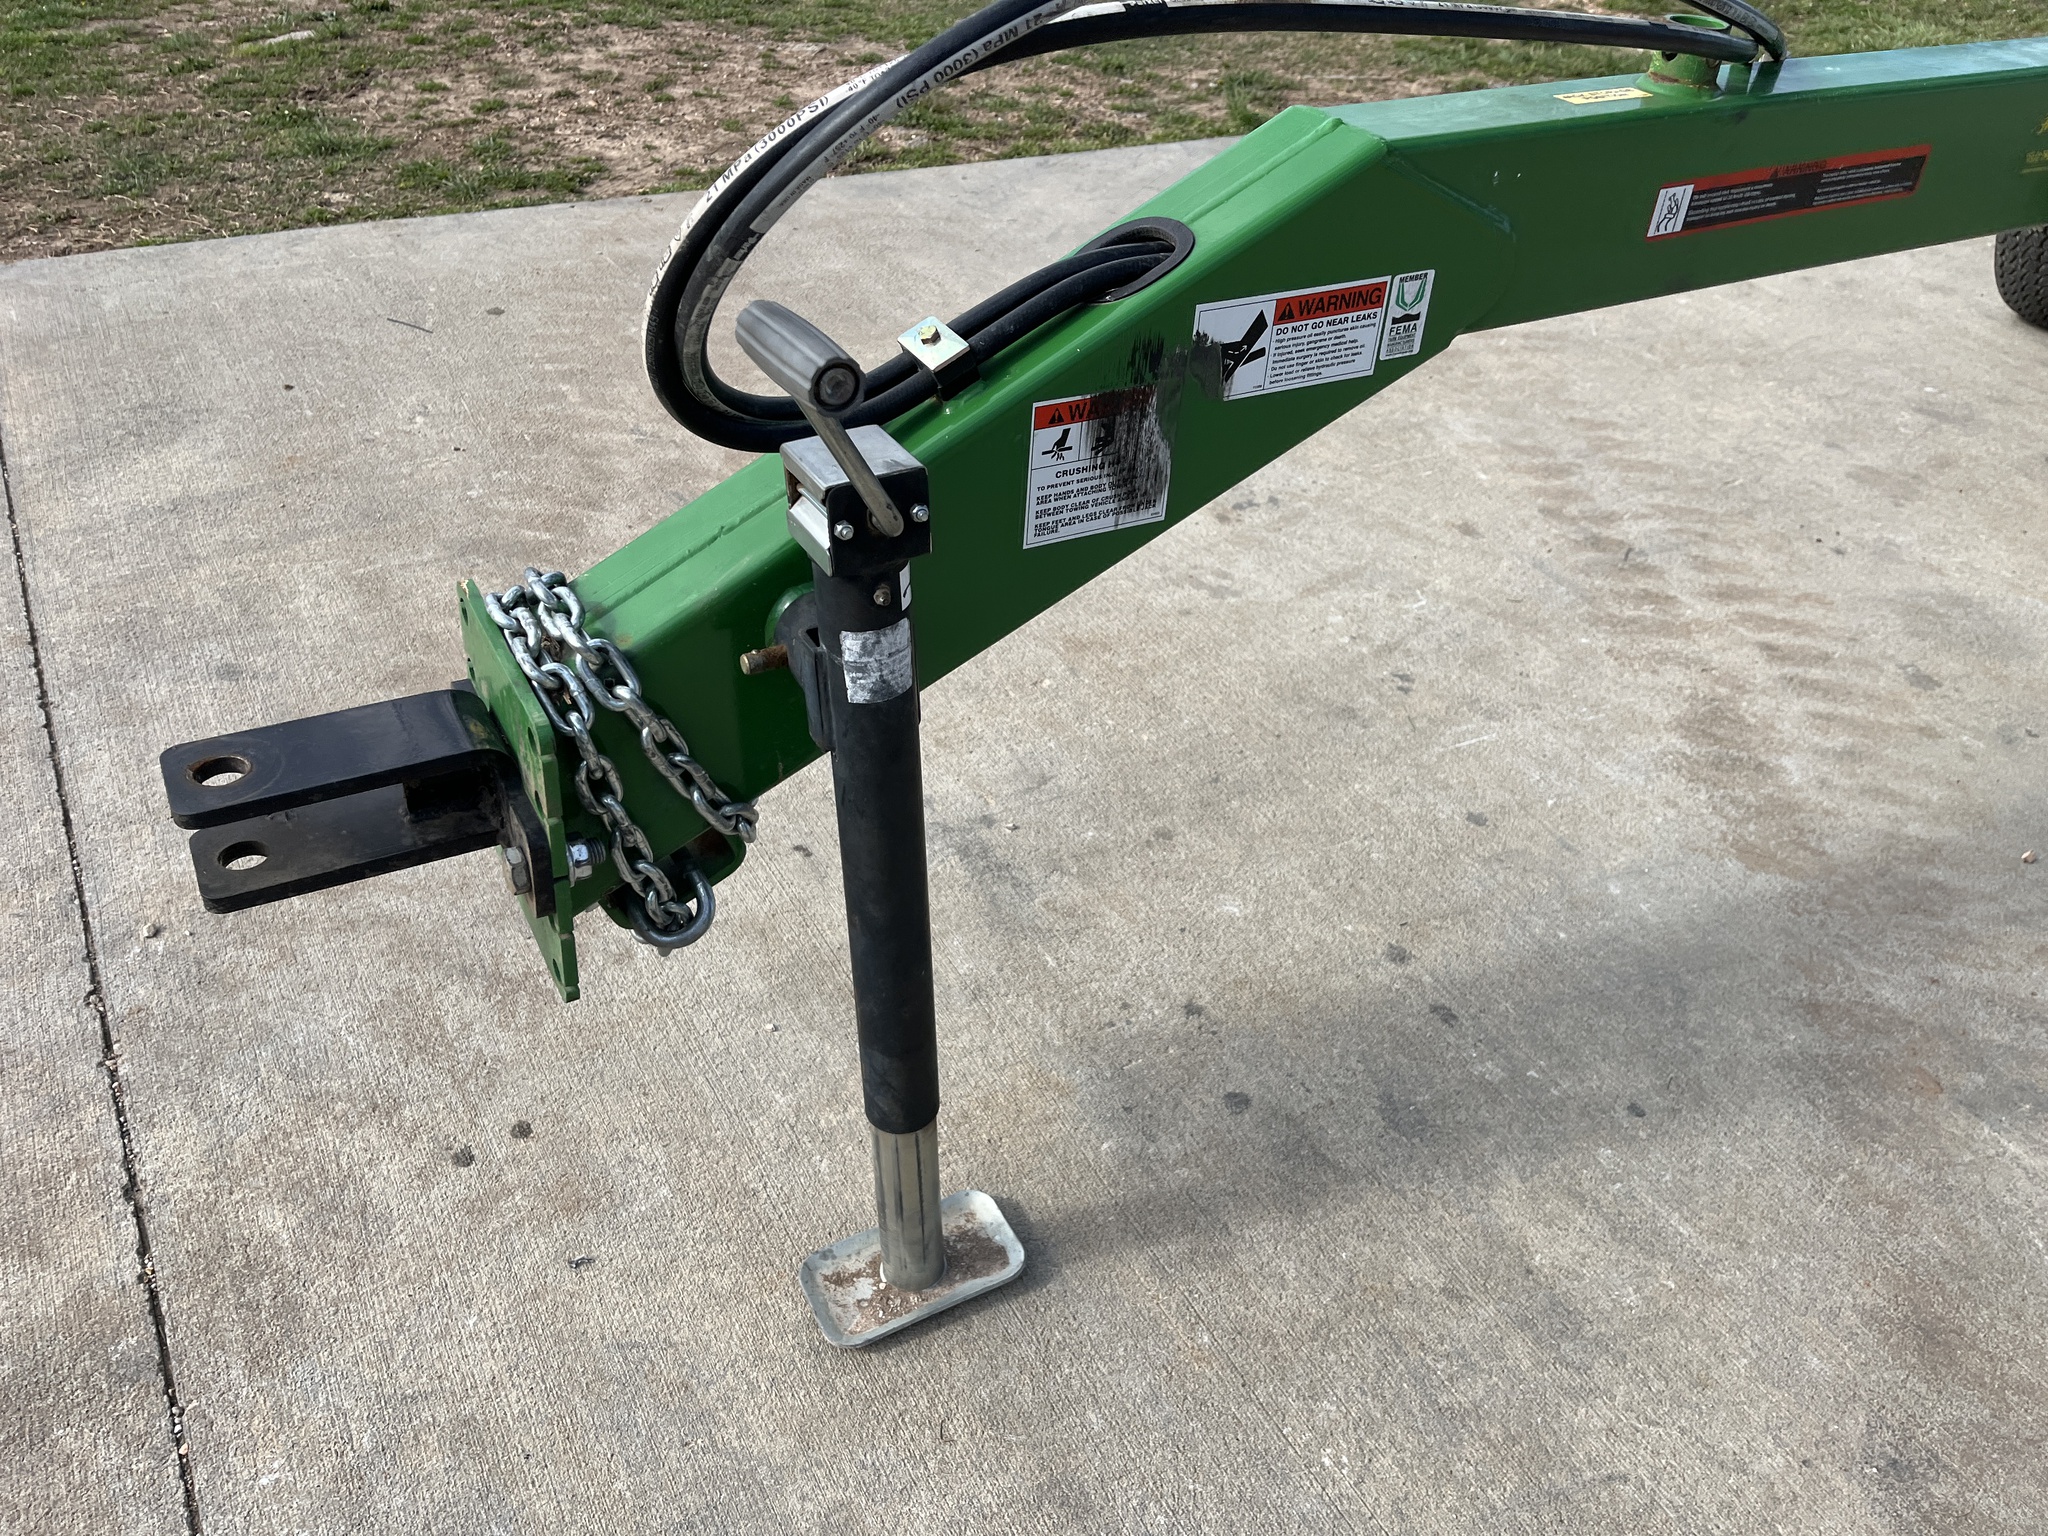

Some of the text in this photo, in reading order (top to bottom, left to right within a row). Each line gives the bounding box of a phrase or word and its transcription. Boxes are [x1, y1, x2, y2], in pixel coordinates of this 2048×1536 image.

[896, 13, 1045, 108] 21 MPa (3000 PSI)
[705, 183, 719, 203] 21
[721, 153, 753, 184] MPa
[754, 96, 829, 153] (3000PSI)
[1399, 272, 1428, 283] MEMBER
[1298, 288, 1382, 316] WARNING
[1276, 312, 1378, 336] DO NOT GO NEAR LEAKS
[1389, 322, 1417, 336] FEMA
[1055, 463, 1105, 478] CRUSHING
[1047, 480, 1074, 490] PREVENT
[1076, 474, 1102, 484] SERIOUS
[1054, 489, 1074, 498] HANDS
[1090, 482, 1106, 490] BODY
[1073, 488, 1106, 498] ATTACHING
[1035, 510, 1064, 520] BETWEEN
[1066, 505, 1089, 513] TOWING
[1091, 499, 1115, 508] VEHICLE
[1070, 500, 1090, 508] CLEAR
[1082, 511, 1097, 519] LEGS
[1099, 507, 1117, 515] CLEAR
[1034, 525, 1058, 533] TONGUE
[1086, 514, 1101, 522] CASE
